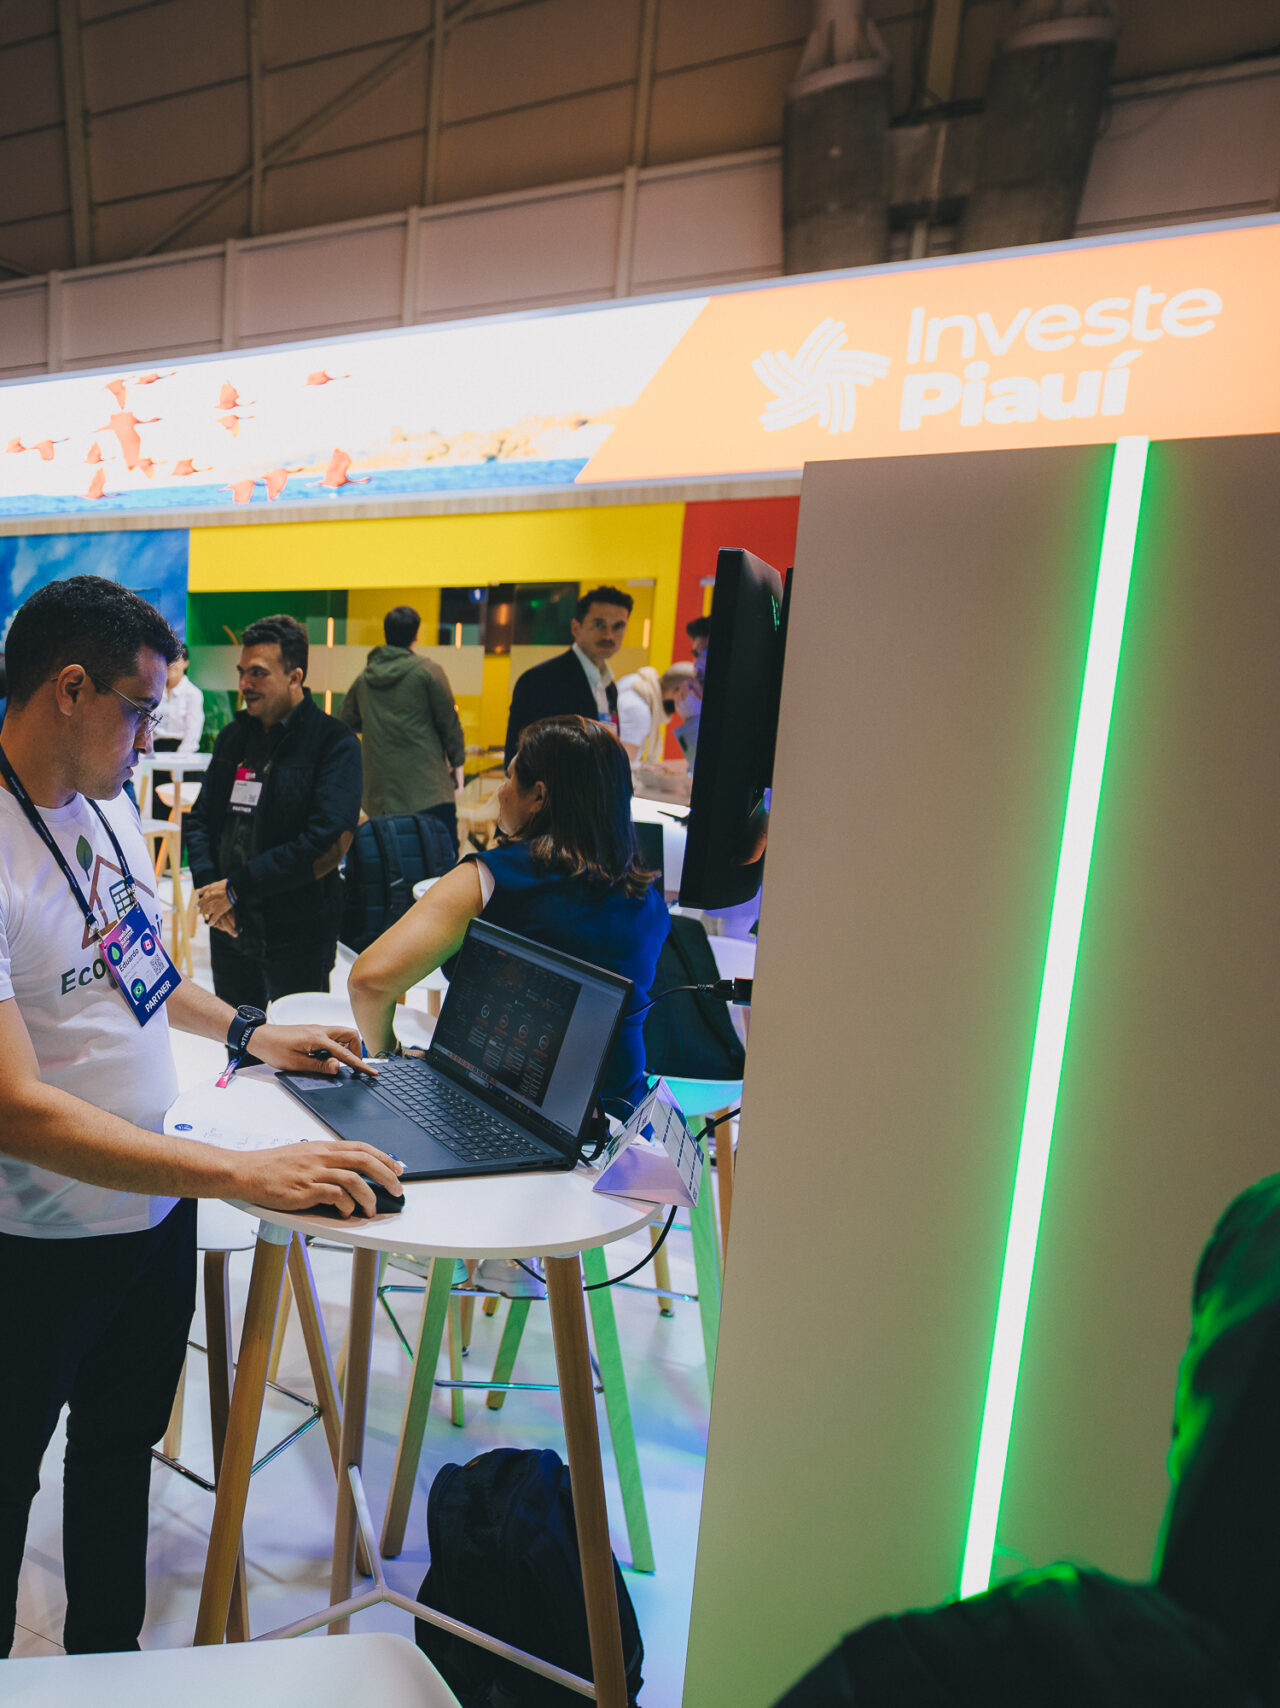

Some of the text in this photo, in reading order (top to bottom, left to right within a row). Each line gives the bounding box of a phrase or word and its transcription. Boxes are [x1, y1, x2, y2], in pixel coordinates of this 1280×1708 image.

[906, 284, 1222, 365] Investe
[899, 349, 1144, 432] Piauí
[119, 948, 140, 973] Eduardo
[144, 980, 173, 1013] PARTNER
